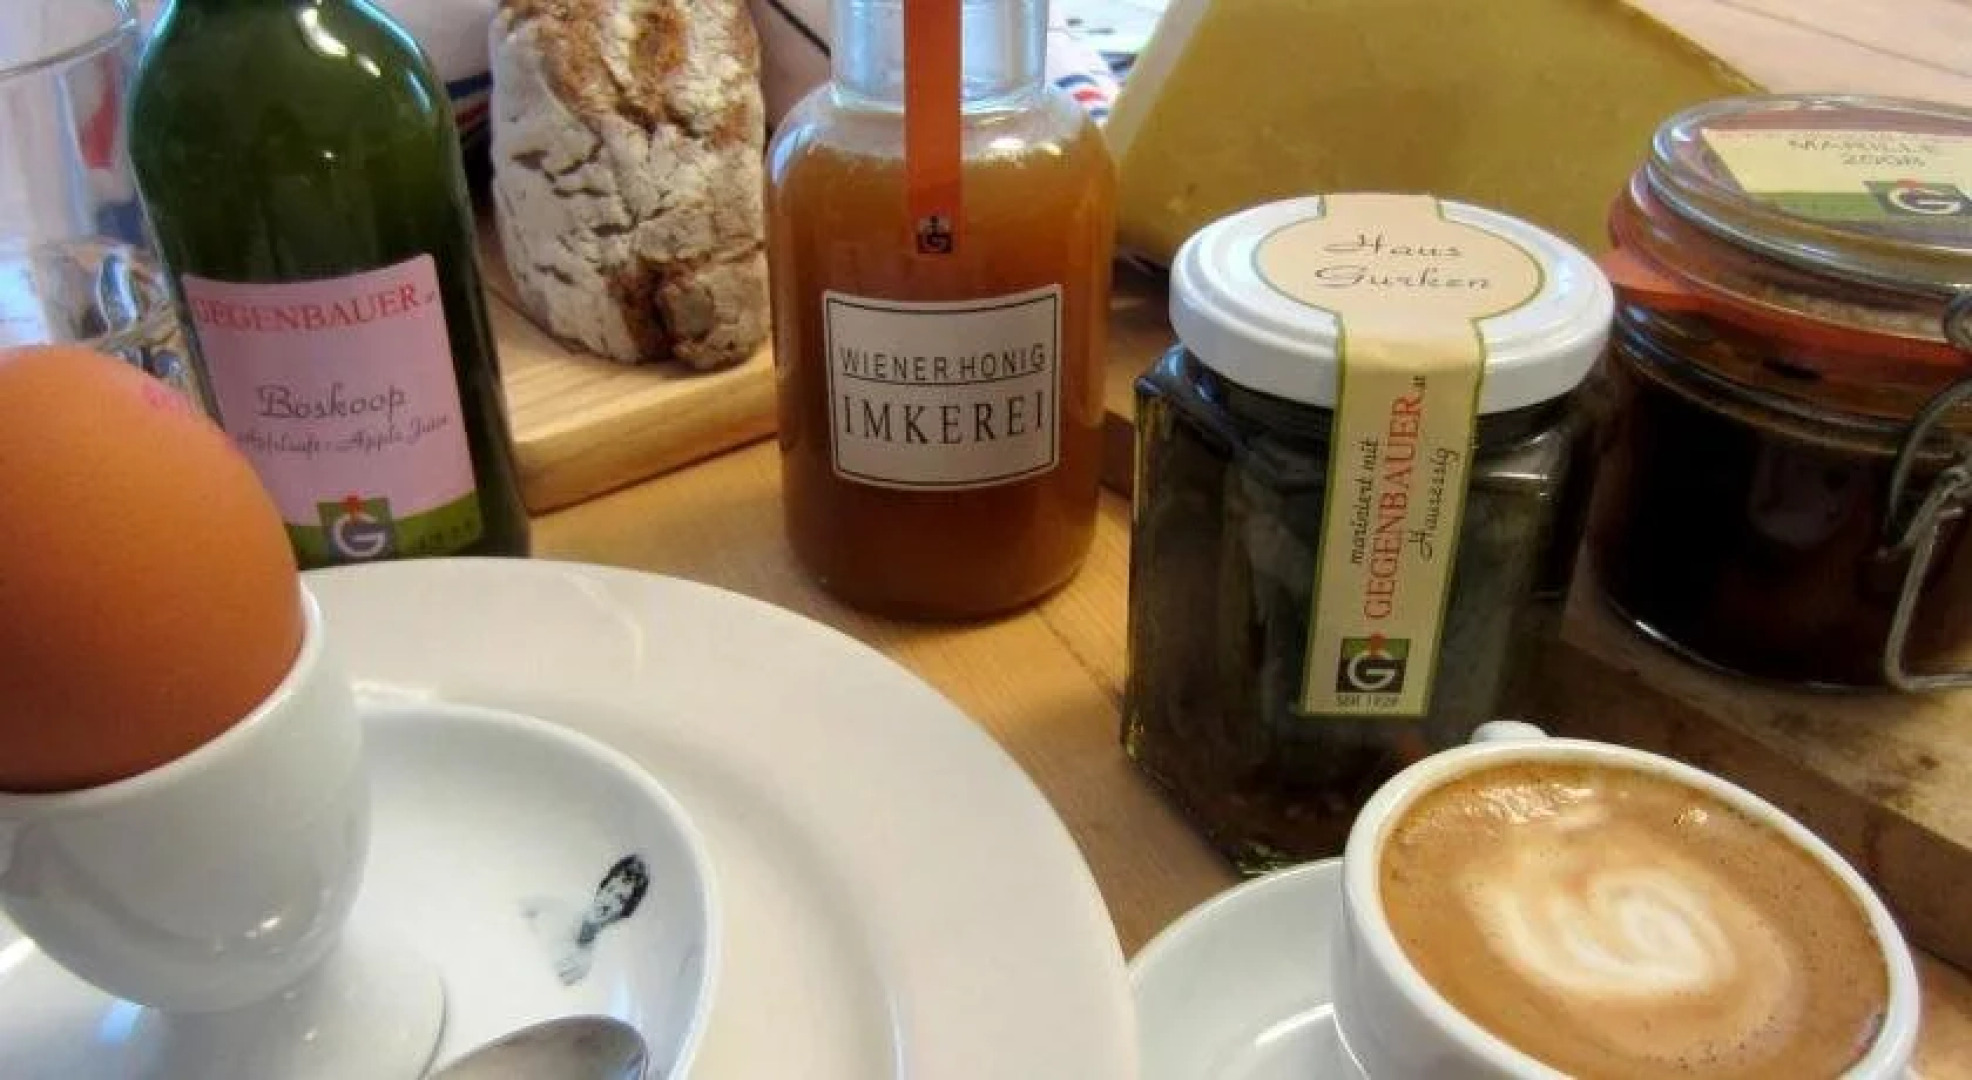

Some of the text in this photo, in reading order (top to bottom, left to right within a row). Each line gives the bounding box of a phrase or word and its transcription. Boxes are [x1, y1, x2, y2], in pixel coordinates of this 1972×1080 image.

[1323, 234, 1463, 257] Haus
[1314, 265, 1490, 290] Gurken
[193, 283, 418, 331] GEGENBAUER
[840, 342, 1047, 382] WIENER HONIG
[254, 381, 408, 424] Boskoop
[844, 390, 1044, 445] IMKEREI
[1360, 436, 1379, 464] mit
[1363, 393, 1425, 621] GEGENBAUER
[1346, 649, 1397, 692] G
